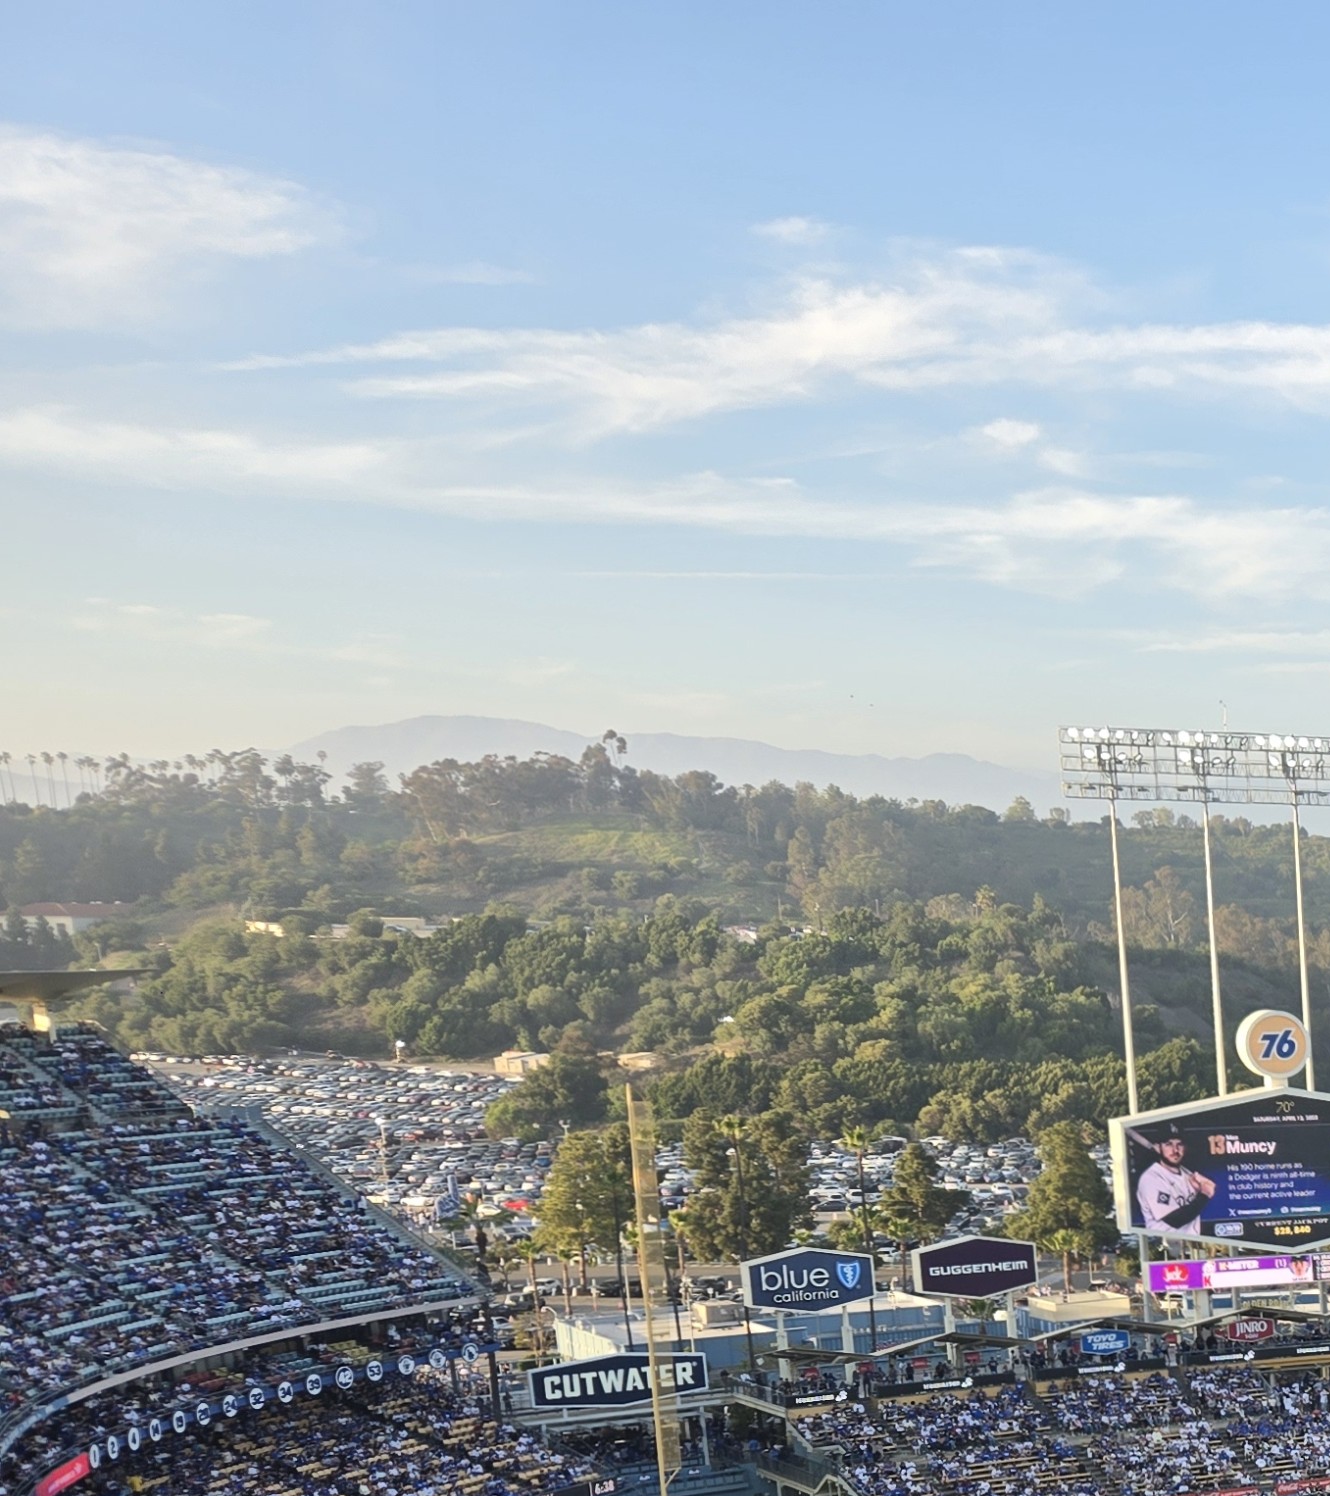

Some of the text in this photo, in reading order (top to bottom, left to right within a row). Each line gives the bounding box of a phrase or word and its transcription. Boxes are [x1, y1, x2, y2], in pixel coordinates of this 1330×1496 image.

[1259, 1029, 1297, 1060] 76
[1276, 1101, 1295, 1113] 70°
[1208, 1135, 1225, 1155] 13
[1226, 1141, 1276, 1155] Muncy
[1227, 1164, 1239, 1172] His
[1254, 1162, 1275, 1170] home
[1234, 1173, 1260, 1181] Dodger
[1270, 1171, 1288, 1179] ninth
[1237, 1182, 1252, 1190] club
[1253, 1182, 1278, 1190] history
[1242, 1191, 1269, 1200] current
[929, 1259, 1029, 1277] GUGGENHEIM
[760, 1263, 830, 1292] blue
[1204, 1275, 1212, 1287] K
[773, 1288, 840, 1303] california
[1236, 1321, 1267, 1337] JINRO
[1087, 1333, 1117, 1344] TOYO
[1092, 1340, 1124, 1352] TIRES
[338, 1370, 352, 1384] 42
[368, 1364, 382, 1377] 53
[544, 1363, 695, 1400] CUTWATER
[279, 1386, 293, 1398] 34
[594, 1480, 615, 1495] 6:38
